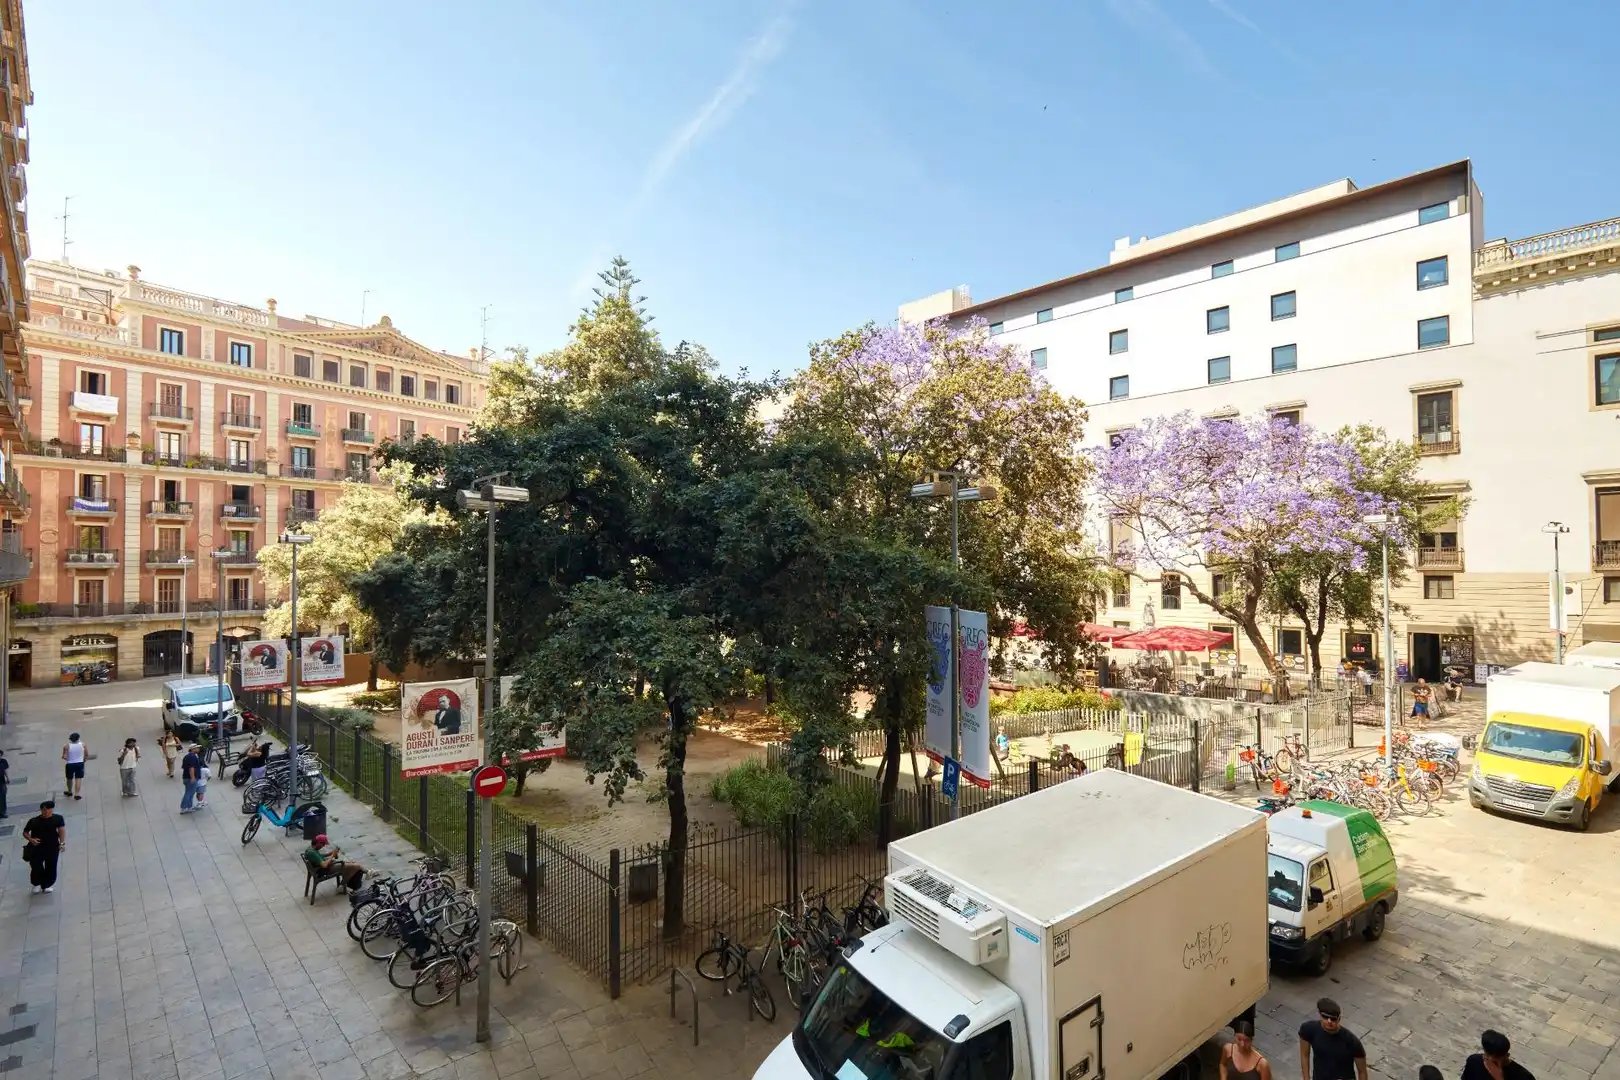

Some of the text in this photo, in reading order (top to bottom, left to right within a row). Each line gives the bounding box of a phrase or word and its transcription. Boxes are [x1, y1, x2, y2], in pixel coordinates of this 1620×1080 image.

[406, 739, 433, 750] DURAN
[440, 734, 474, 745] SANPERE
[406, 768, 438, 777] Barcelona
[947, 763, 955, 777] P
